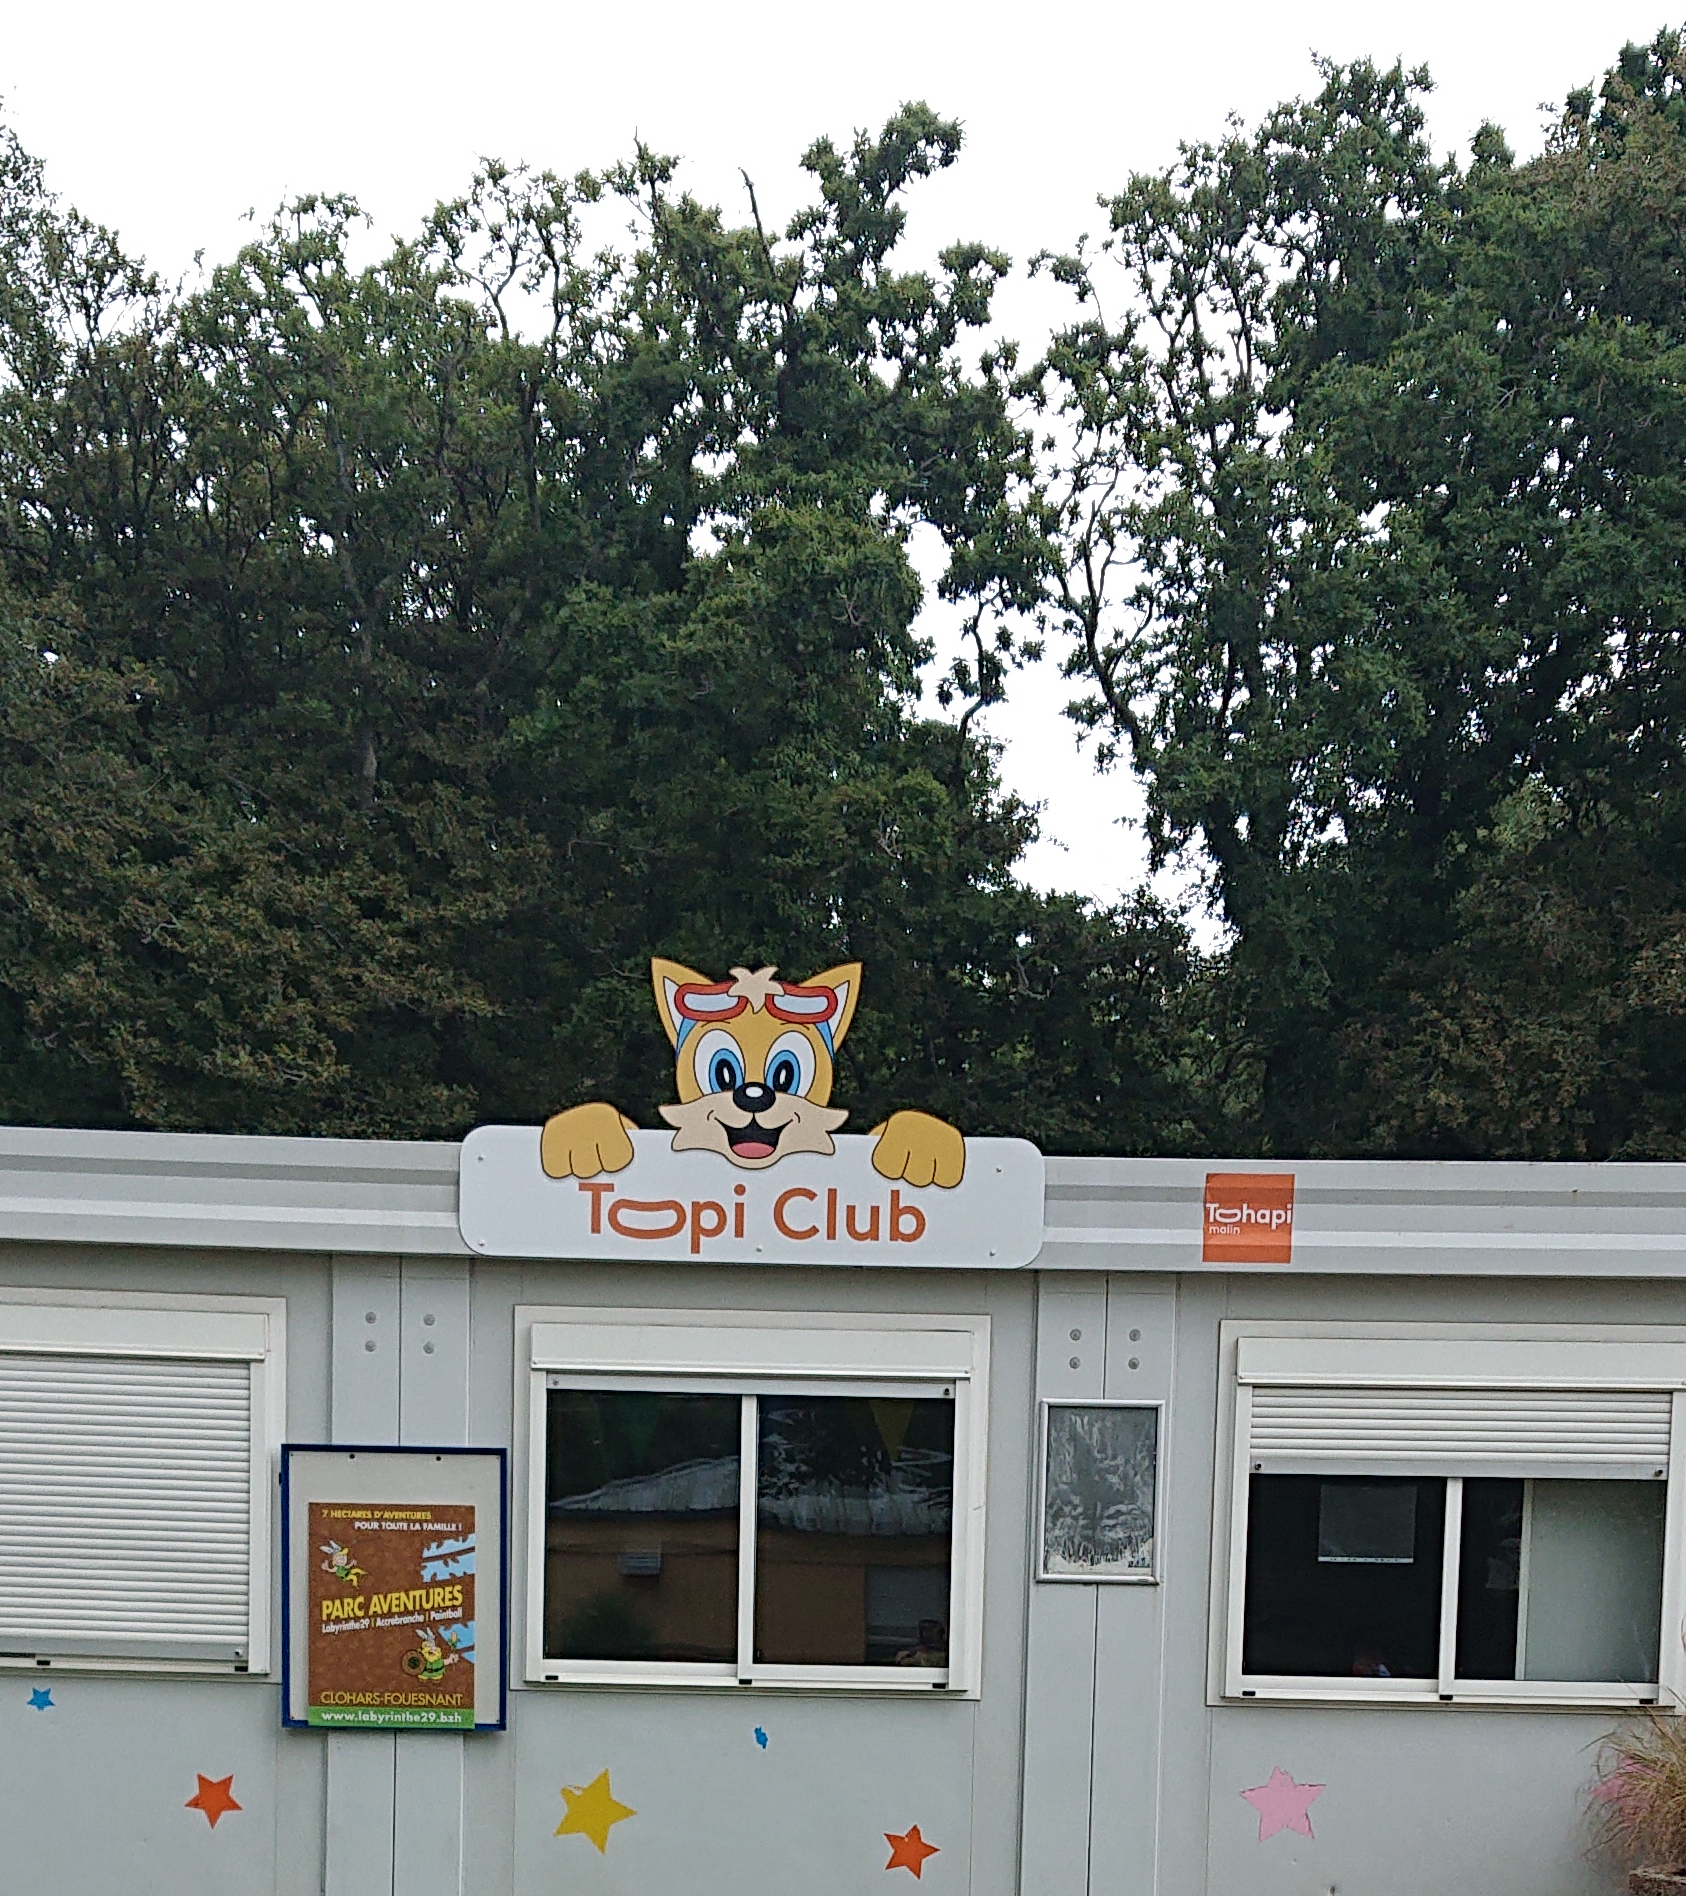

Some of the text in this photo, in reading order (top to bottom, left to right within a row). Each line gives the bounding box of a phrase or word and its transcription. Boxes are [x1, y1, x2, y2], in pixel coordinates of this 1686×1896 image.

[772, 1187, 927, 1243] Club
[322, 1510, 432, 1520] 7 HECTARES D'AVENTURES
[354, 1521, 379, 1530] POUR
[382, 1521, 408, 1530] TOUTE
[410, 1522, 421, 1530] LA
[423, 1522, 456, 1531] FAMILLE
[321, 1585, 464, 1621] PARC AVENTURES
[321, 1607, 463, 1635] Labyrinthe29 Accrobranche Paintball
[320, 1691, 463, 1705] CLOHARS-FOUESNANT
[321, 1710, 462, 1724] www.labyrinthe29.bzh
